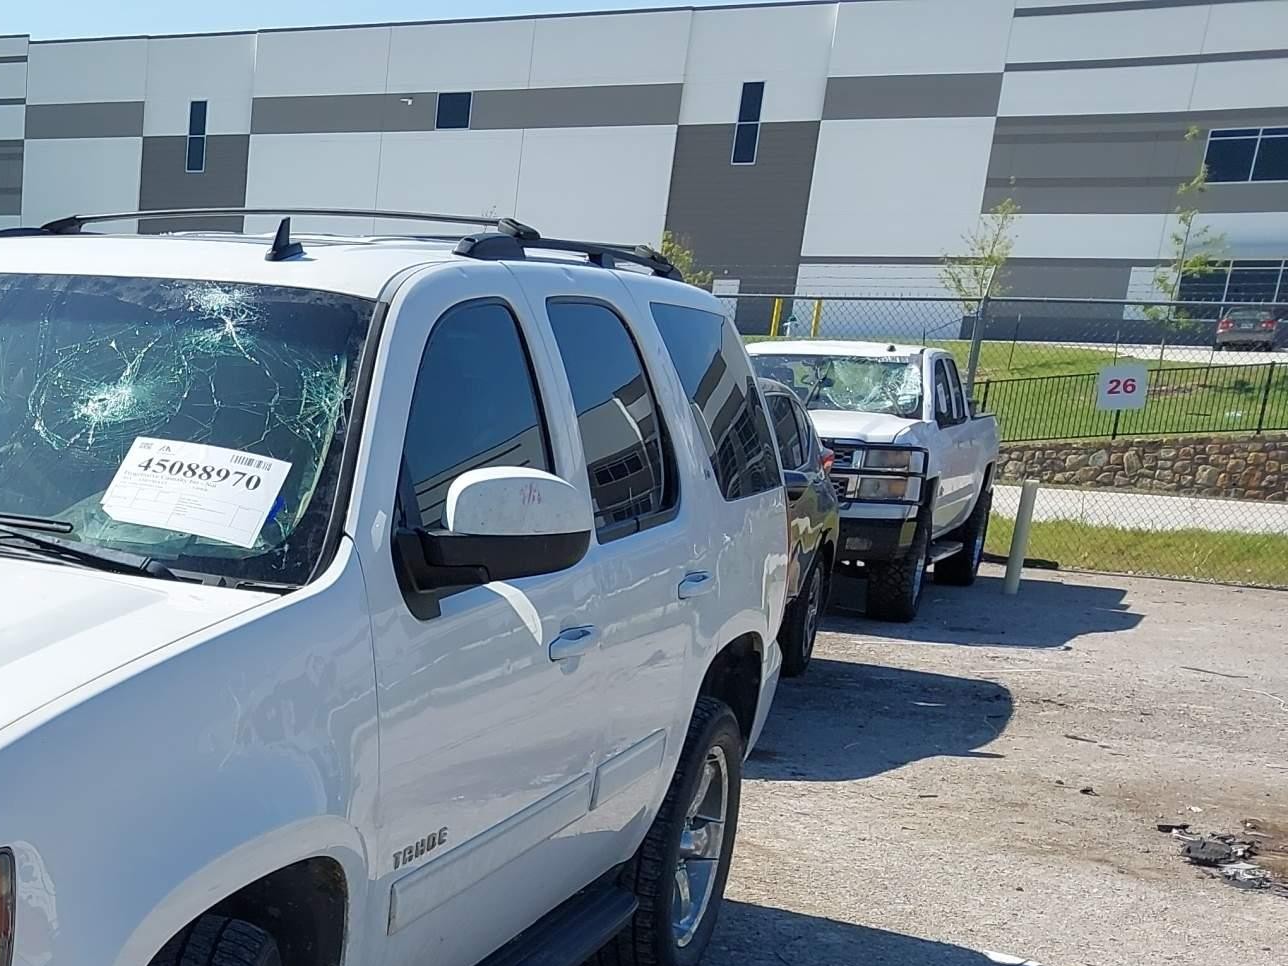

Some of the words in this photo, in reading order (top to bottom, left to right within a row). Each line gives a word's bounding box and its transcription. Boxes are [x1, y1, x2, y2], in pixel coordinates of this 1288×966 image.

[1107, 378, 1137, 395] 26
[137, 456, 262, 491] 45088970
[392, 826, 448, 870] TAHOE
